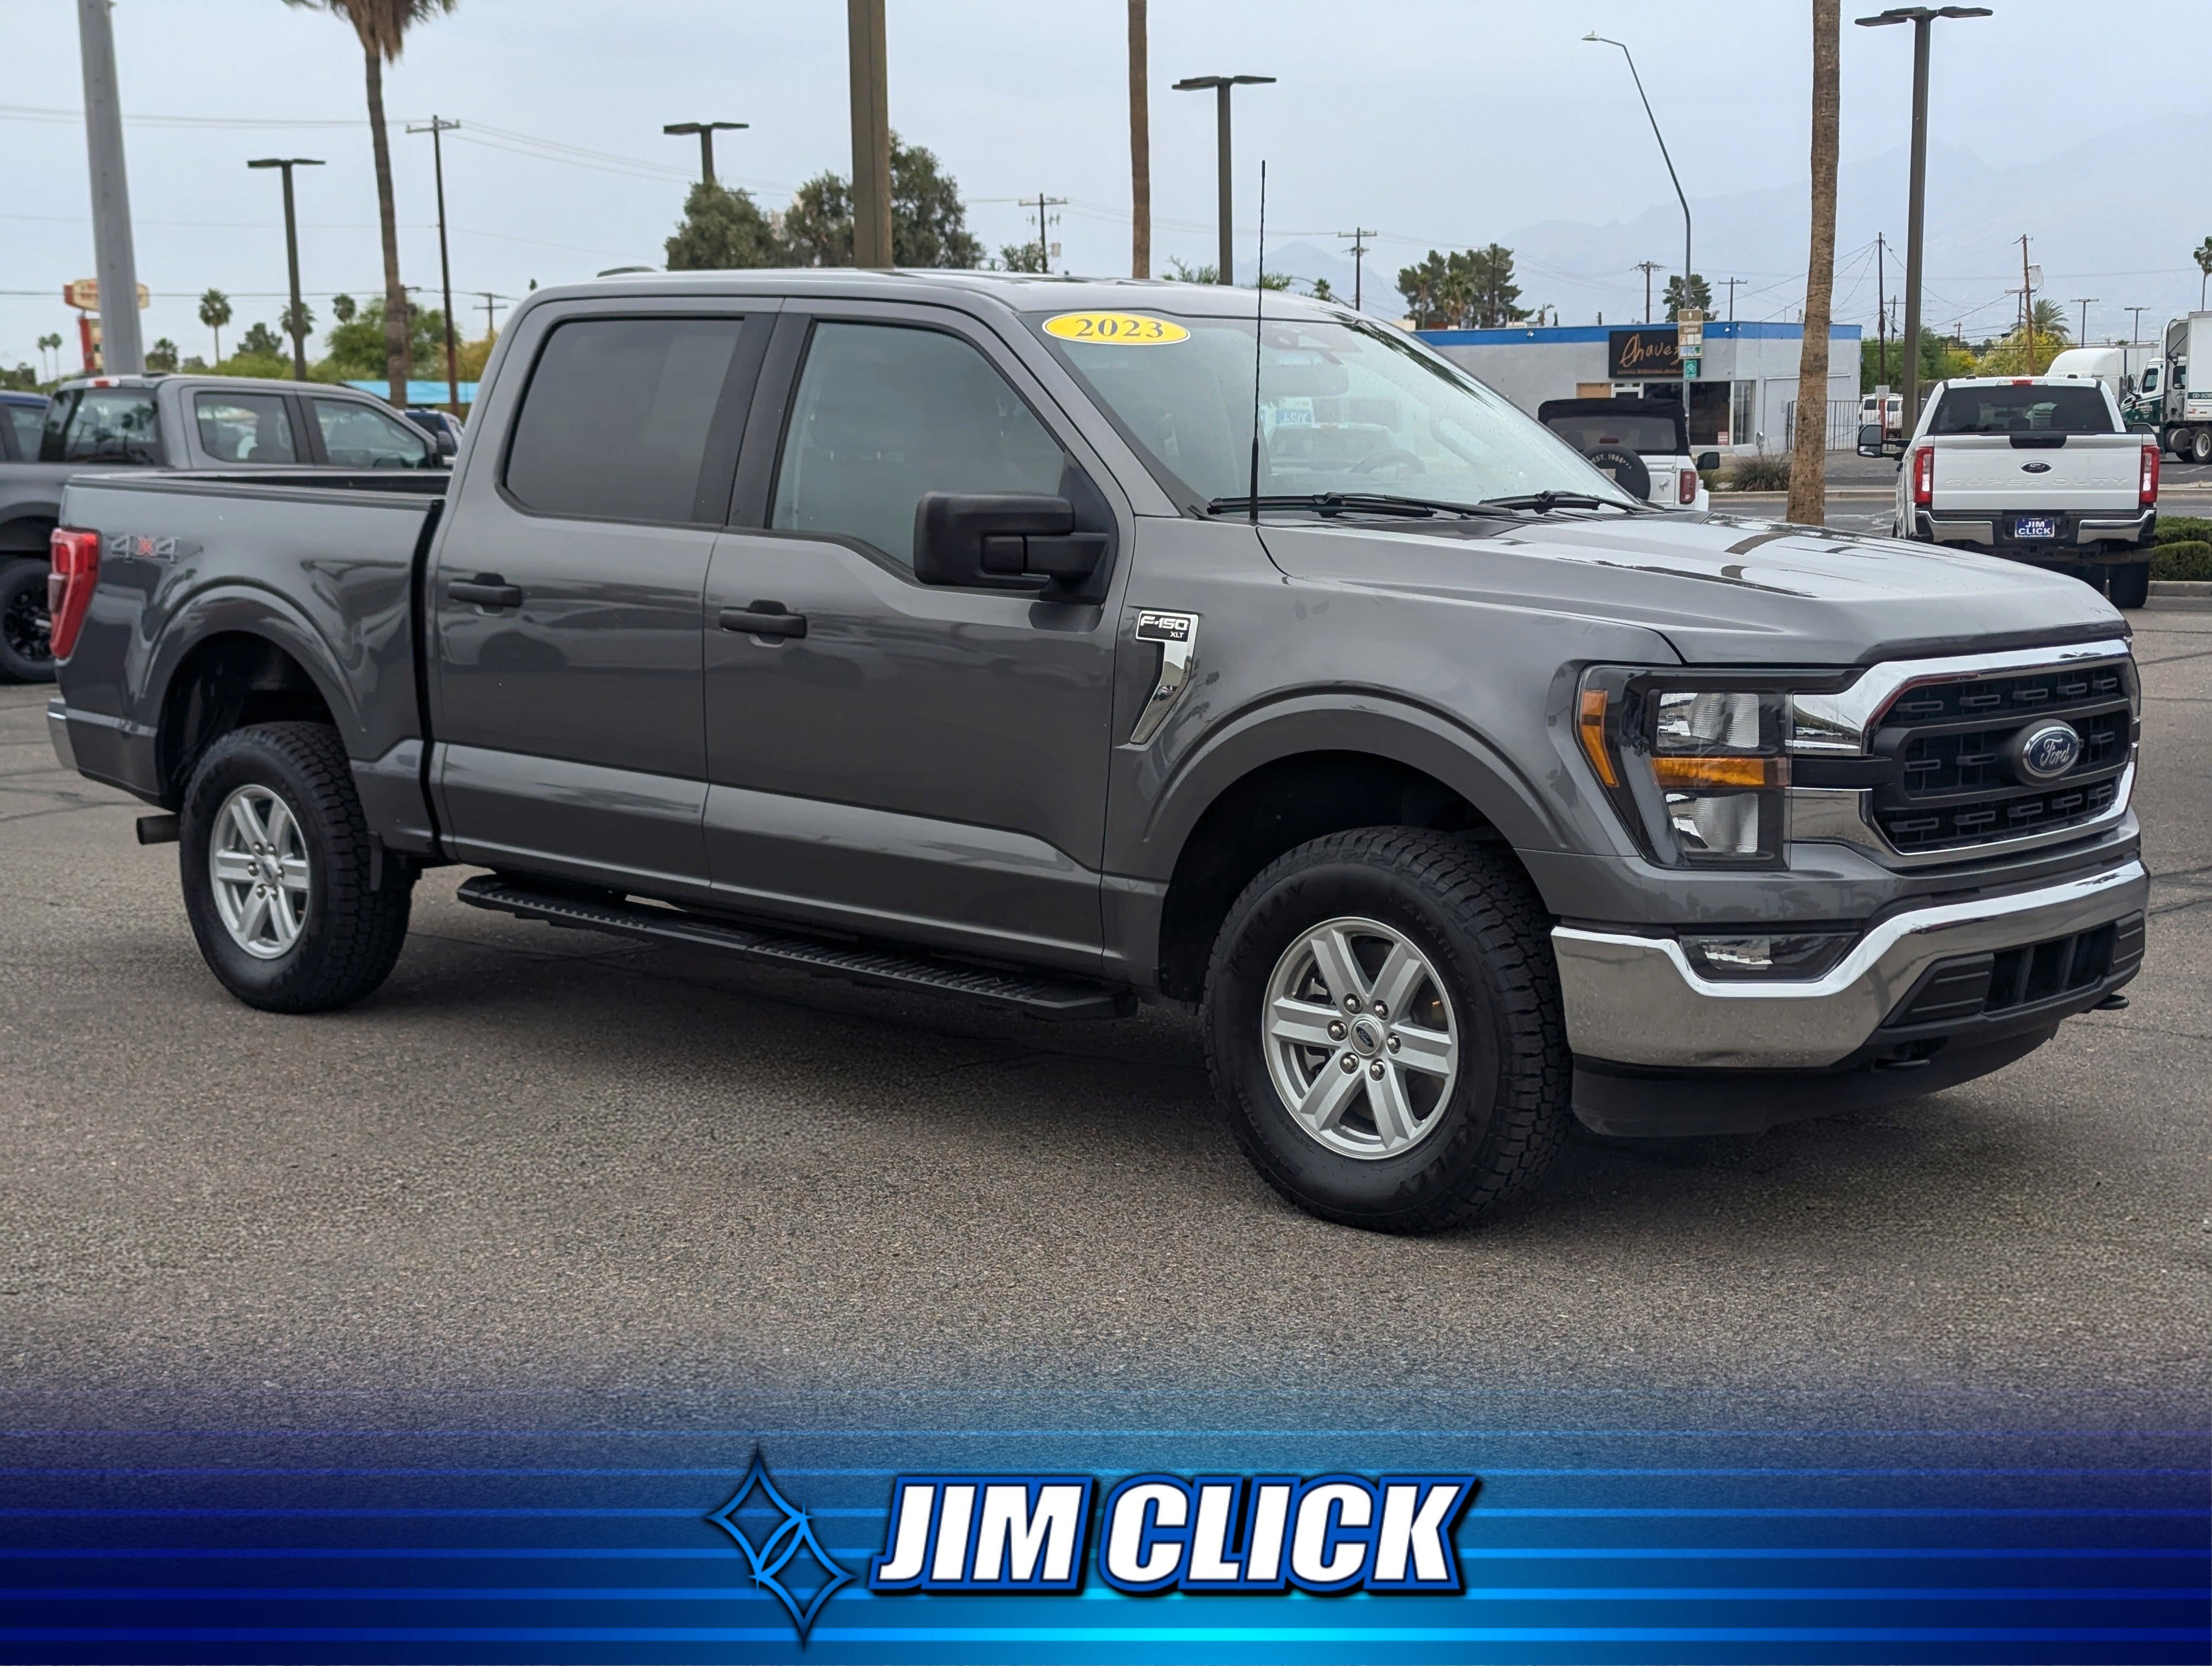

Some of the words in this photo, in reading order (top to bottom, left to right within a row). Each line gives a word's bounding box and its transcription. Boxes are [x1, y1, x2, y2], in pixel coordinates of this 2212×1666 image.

[1075, 318, 1163, 338] 2023
[1608, 453, 1624, 463] 1966
[1945, 478, 2043, 486] SUPER
[1140, 616, 1189, 631] F-150
[2040, 738, 2070, 767] Ford
